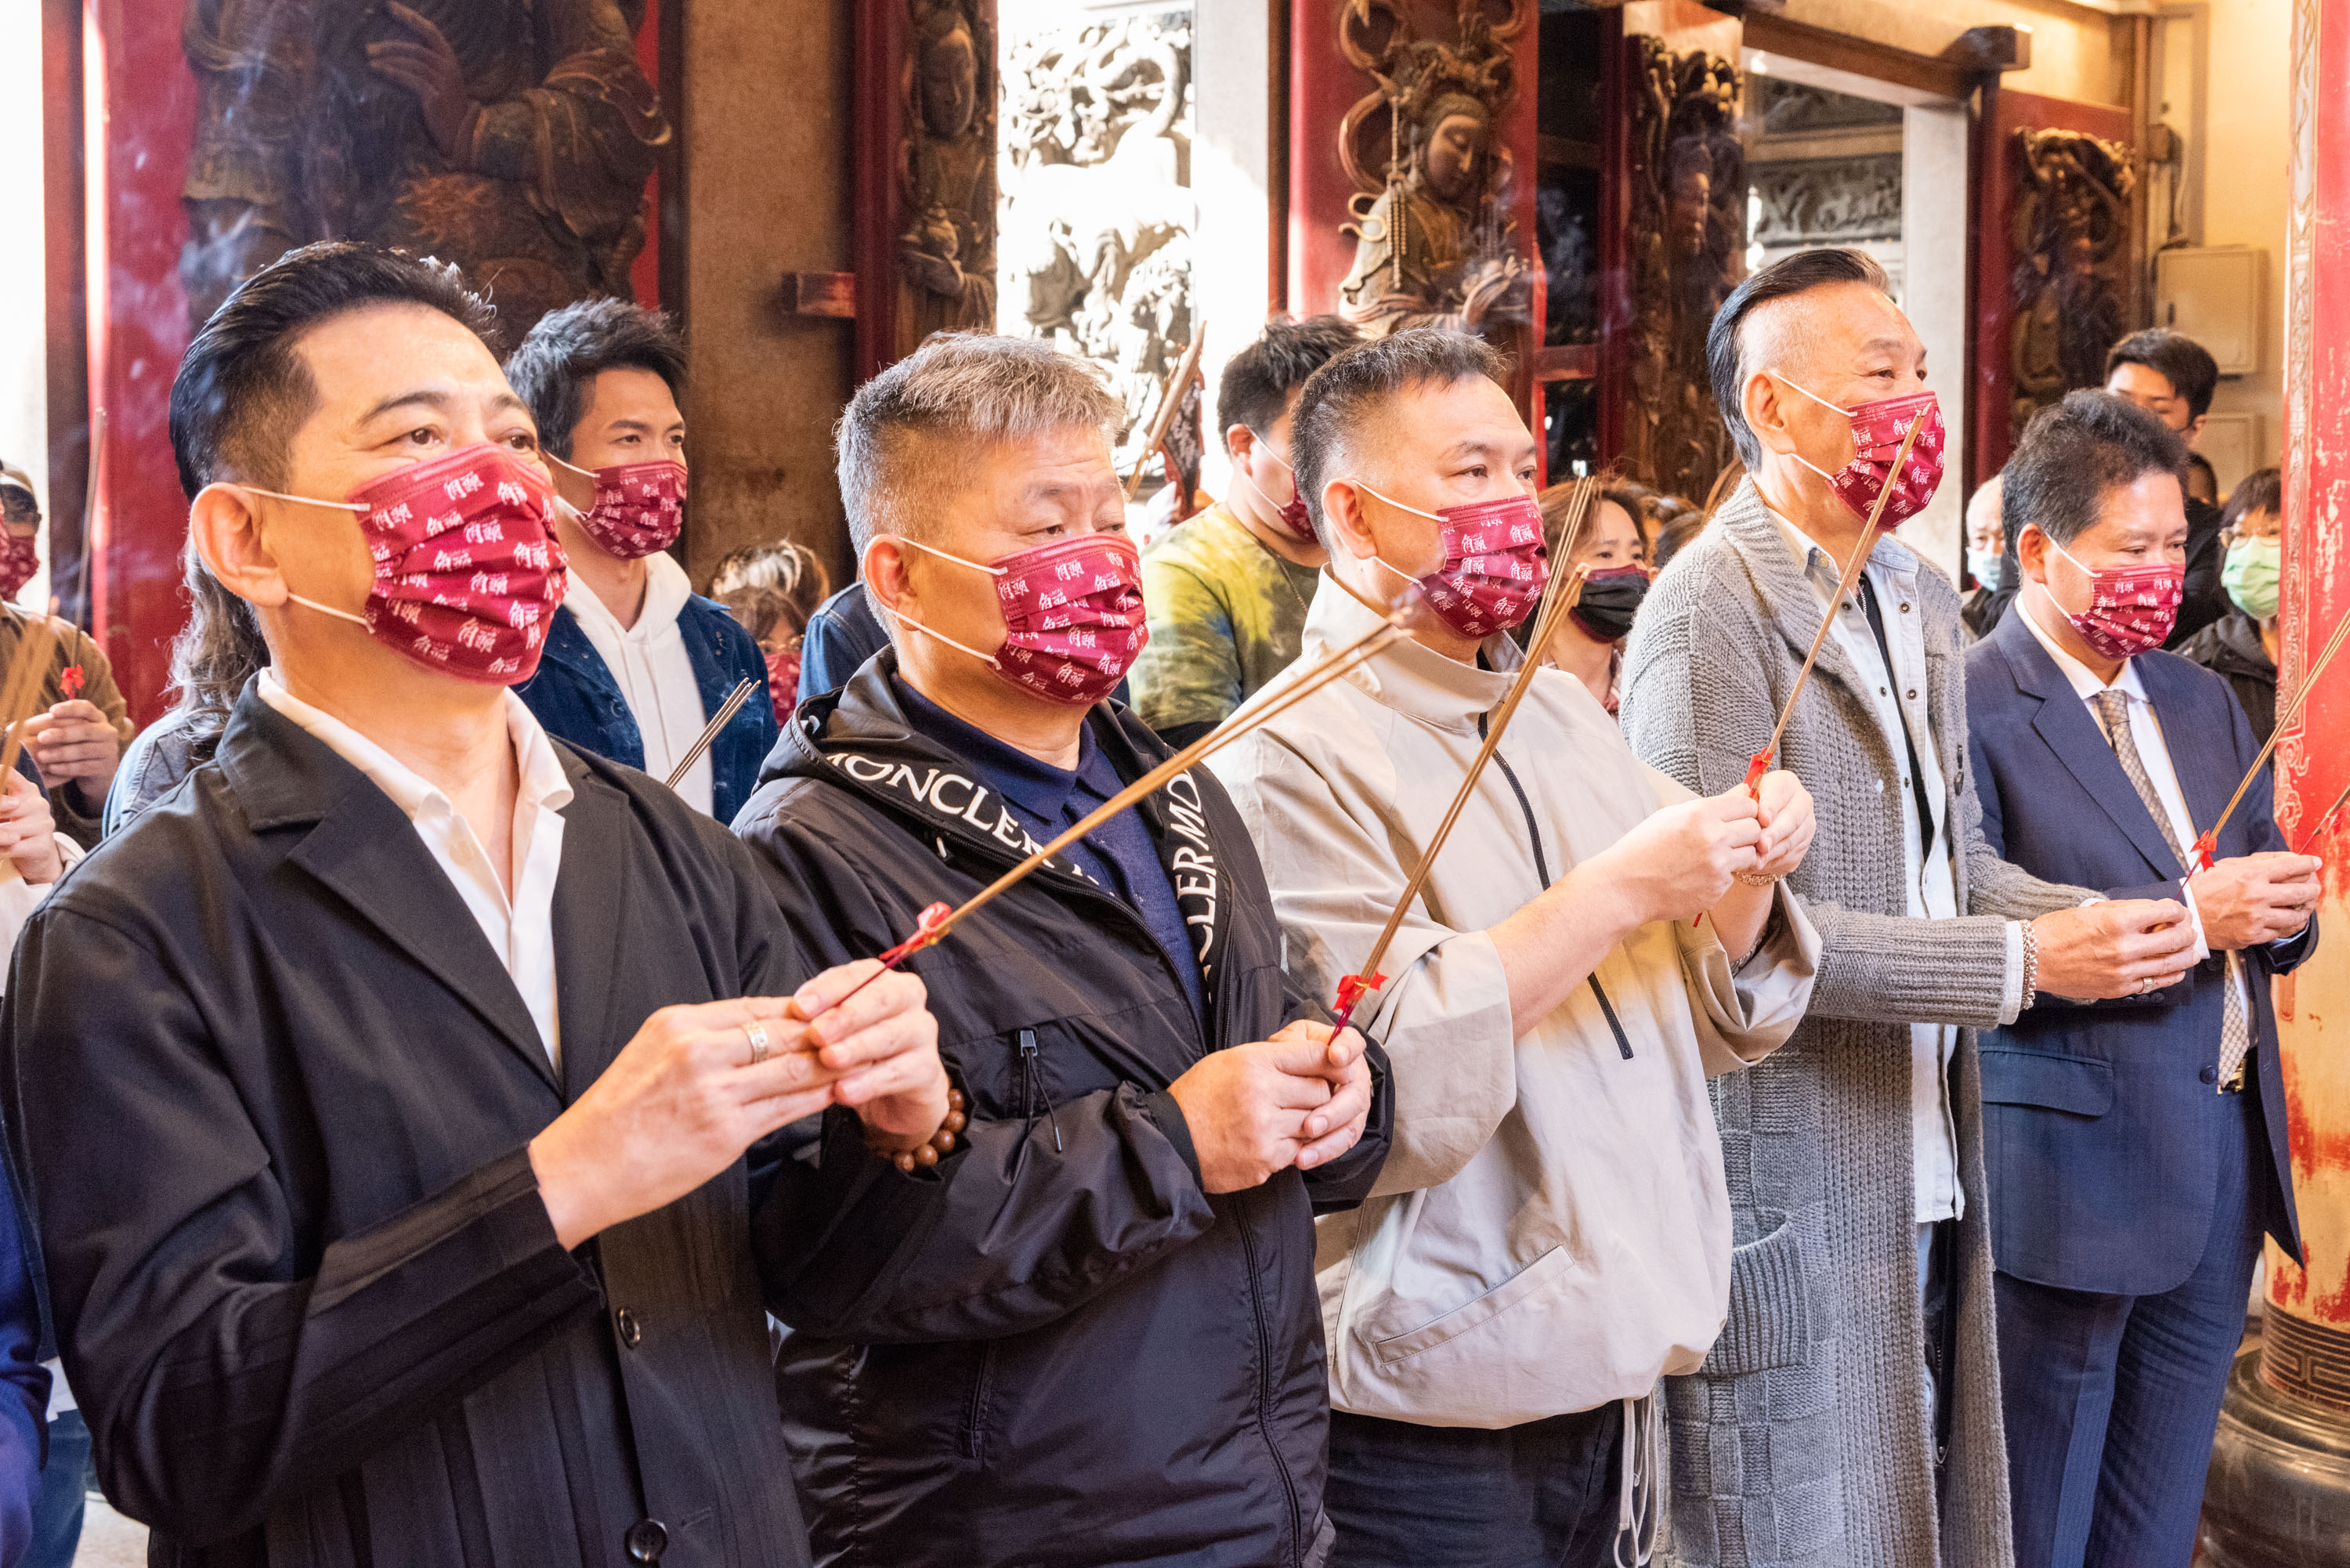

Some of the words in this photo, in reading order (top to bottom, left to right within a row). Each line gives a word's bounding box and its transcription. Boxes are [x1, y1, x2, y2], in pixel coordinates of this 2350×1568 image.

[1912, 466, 1930, 485] 角頭
[1462, 534, 1488, 553] 角頭
[1510, 524, 1536, 543] 角頭
[1054, 559, 1084, 581] 角頭
[1462, 557, 1485, 575] 角頭
[1510, 561, 1532, 581] 角頭
[998, 578, 1029, 601] 角頭
[1451, 576, 1474, 599] 角頭
[1494, 597, 1517, 616] 角頭
[1067, 625, 1096, 649] 角頭
[1056, 662, 1086, 688] 角頭
[1097, 653, 1123, 677] 角頭
